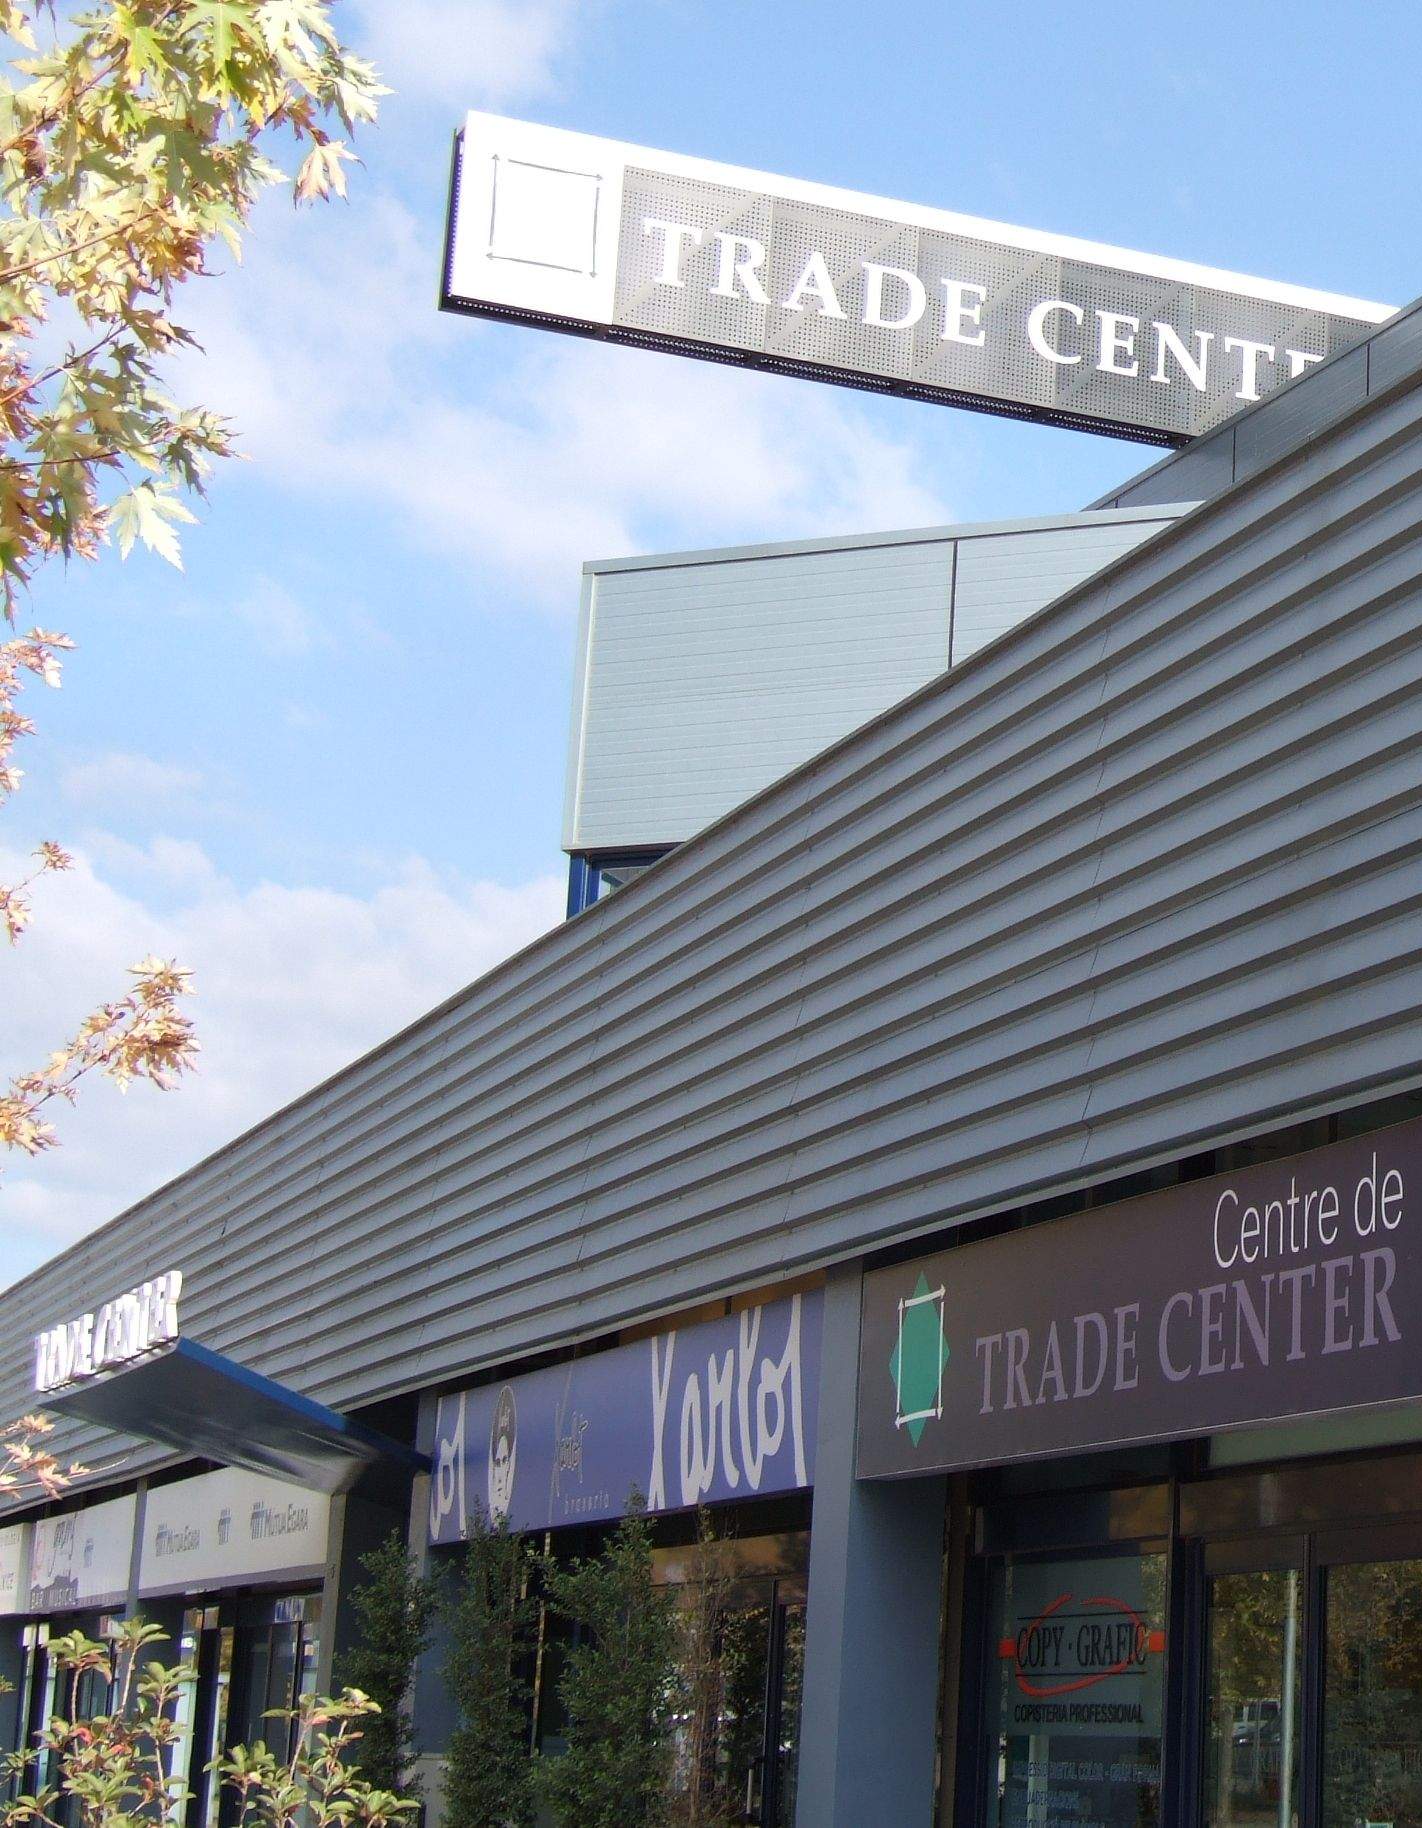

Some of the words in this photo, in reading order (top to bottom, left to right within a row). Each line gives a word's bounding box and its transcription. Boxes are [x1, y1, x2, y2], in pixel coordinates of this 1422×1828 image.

[644, 218, 987, 346] TRADE
[1027, 299, 1325, 401] CENT
[1213, 1176, 1339, 1268] Centre
[1353, 1152, 1404, 1237] de
[975, 1303, 1140, 1415] TRADE
[1158, 1247, 1402, 1382] CENTER
[1017, 1626, 1065, 1668] COPY
[1077, 1622, 1149, 1667] GRAFIC
[1015, 1704, 1067, 1723] COPISTERIA
[1069, 1703, 1144, 1724] PROFESSIONAL
